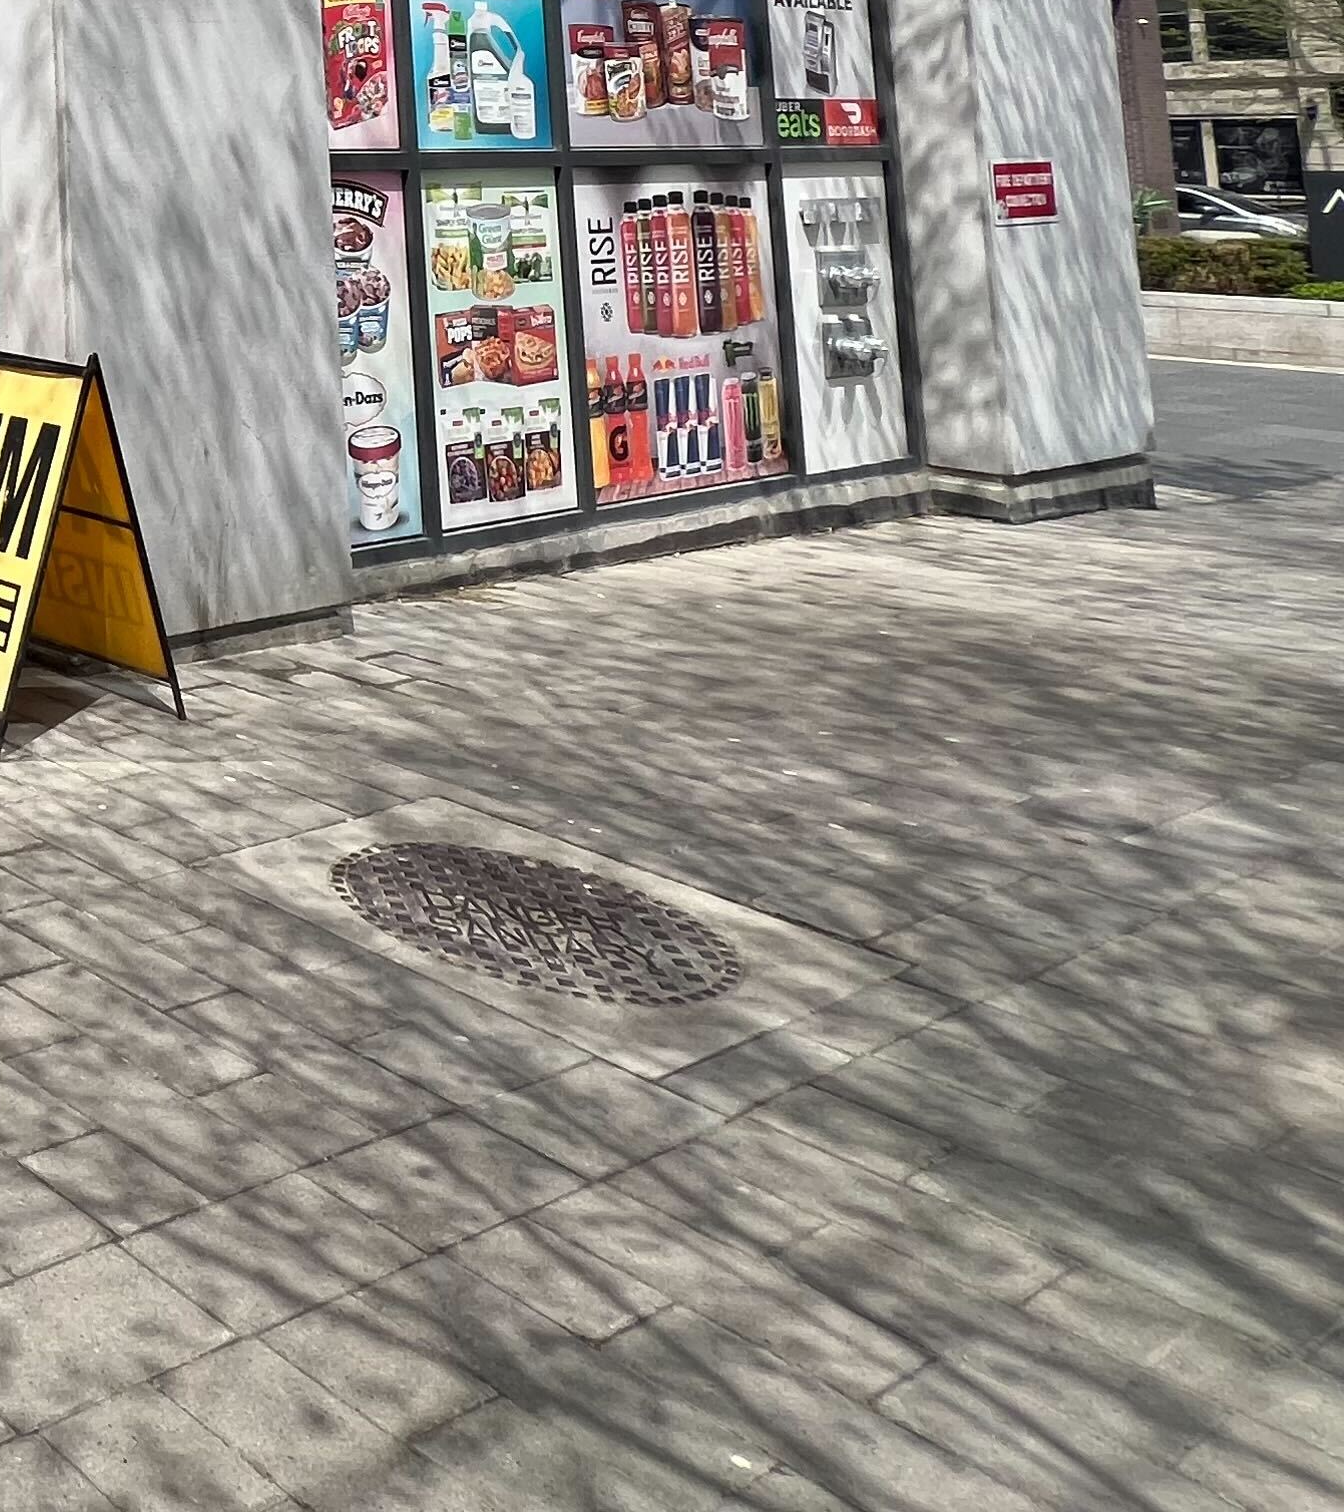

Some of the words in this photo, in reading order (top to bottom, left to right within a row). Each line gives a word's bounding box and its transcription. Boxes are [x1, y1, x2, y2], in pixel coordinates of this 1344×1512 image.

[777, 110, 821, 138] eats
[828, 125, 877, 137] DOORDASH
[334, 188, 383, 219] ERRY'S
[587, 215, 617, 287] RISE
[672, 237, 689, 284] RISE
[698, 236, 715, 282] RISE
